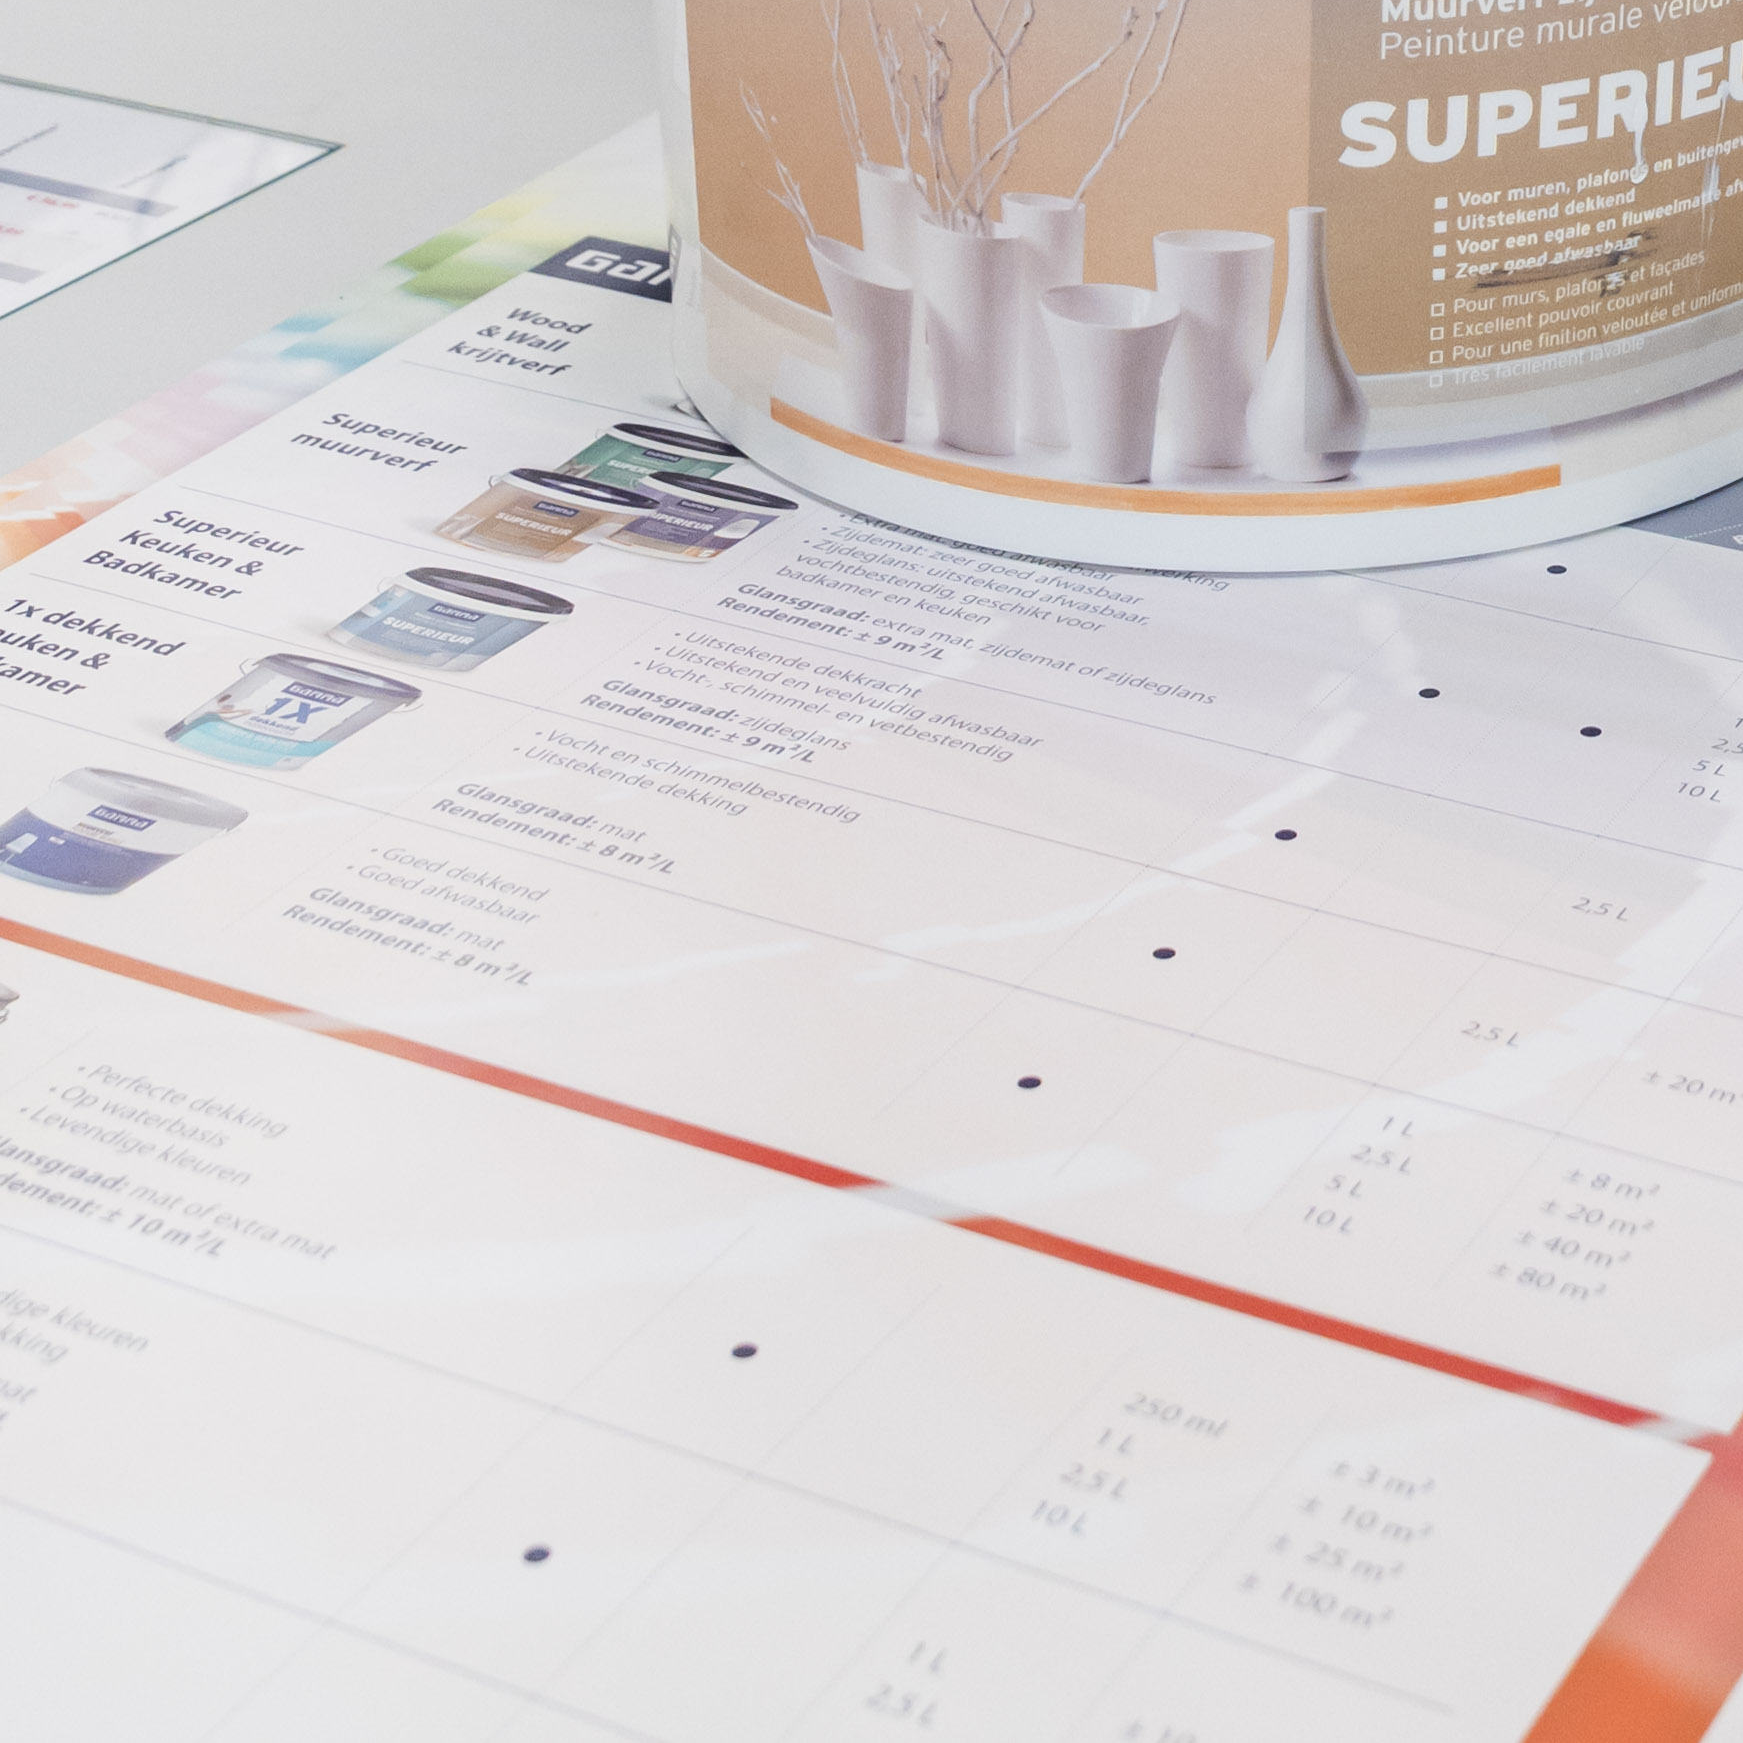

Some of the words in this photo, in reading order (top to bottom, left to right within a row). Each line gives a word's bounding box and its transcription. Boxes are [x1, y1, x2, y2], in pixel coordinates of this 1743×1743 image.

[1380, 28, 1525, 60] Peinture
[1537, 9, 1643, 43] murale
[1458, 190, 1501, 207] Voor
[1508, 181, 1570, 202] muren,
[1654, 160, 1672, 173] en
[1457, 203, 1558, 232] Uitstekend
[1565, 188, 1636, 216] dekkend
[1455, 261, 1498, 279] Zeer
[1504, 252, 1548, 274] goed
[1553, 235, 1641, 263] afwasbaar
[1456, 238, 1498, 255] Voor
[1505, 232, 1538, 246] een
[1544, 223, 1590, 244] egale
[1597, 217, 1616, 232] en
[1454, 298, 1495, 313] Pour
[1502, 289, 1548, 306] murs,
[1556, 273, 1626, 300] plafons
[1631, 268, 1645, 284] et
[1650, 250, 1705, 279] façades
[506, 307, 592, 335] Wood
[1452, 316, 1532, 338] Excellent
[1539, 299, 1601, 327] pouvoir
[1607, 281, 1676, 312] couvrant
[1452, 345, 1494, 361] Pour
[1501, 337, 1532, 353] une
[1539, 324, 1597, 348] finition
[1602, 304, 1667, 336] veloutée
[1672, 301, 1686, 315] et
[447, 342, 572, 378] krijtverf
[477, 326, 501, 338] &
[504, 328, 571, 353] Wall
[291, 433, 437, 473] muurverf
[322, 412, 467, 456] Superieur
[153, 509, 304, 557] Superieur
[494, 512, 572, 537] SUPERIEUR
[83, 551, 243, 601] Badkamer
[118, 530, 230, 568] Keuken
[235, 561, 264, 577] &
[833, 526, 924, 558] Zijdemat:
[928, 550, 972, 569] zeer
[978, 561, 1033, 584] goed
[1037, 573, 1144, 604] afwasbaar
[777, 566, 879, 600] badkamer
[883, 592, 911, 606] en
[917, 598, 991, 625] keuken
[796, 554, 957, 601] vochtbestendig,
[962, 592, 1049, 621] geschikt
[1053, 612, 1105, 632] voor
[812, 540, 924, 576] Zijdeglans:
[927, 568, 1035, 599] uitstekend
[1039, 588, 1151, 626] afwasbaar,
[0, 629, 83, 661] uken
[91, 652, 112, 670] &
[4, 599, 43, 619] 1x
[43, 610, 186, 657] dekkend
[382, 615, 476, 647] SUPERIEUR
[717, 597, 852, 639] Rendement:
[853, 631, 872, 644] ±
[873, 634, 893, 647] 9
[893, 640, 944, 661] m²/L
[737, 583, 870, 624] Glansgraad:
[872, 616, 924, 640] extra
[930, 627, 975, 650] mat,
[979, 642, 1073, 678] zijdemat
[1077, 660, 1103, 678] of
[1102, 669, 1217, 705] zijdeglans
[686, 631, 811, 672] Uitstekende
[812, 664, 923, 701] dekkracht
[264, 698, 328, 725] 1X
[382, 847, 445, 874] Goed
[446, 864, 550, 903] dekkend
[88, 1064, 188, 1105] Perfecte
[189, 1098, 288, 1139] dekking
